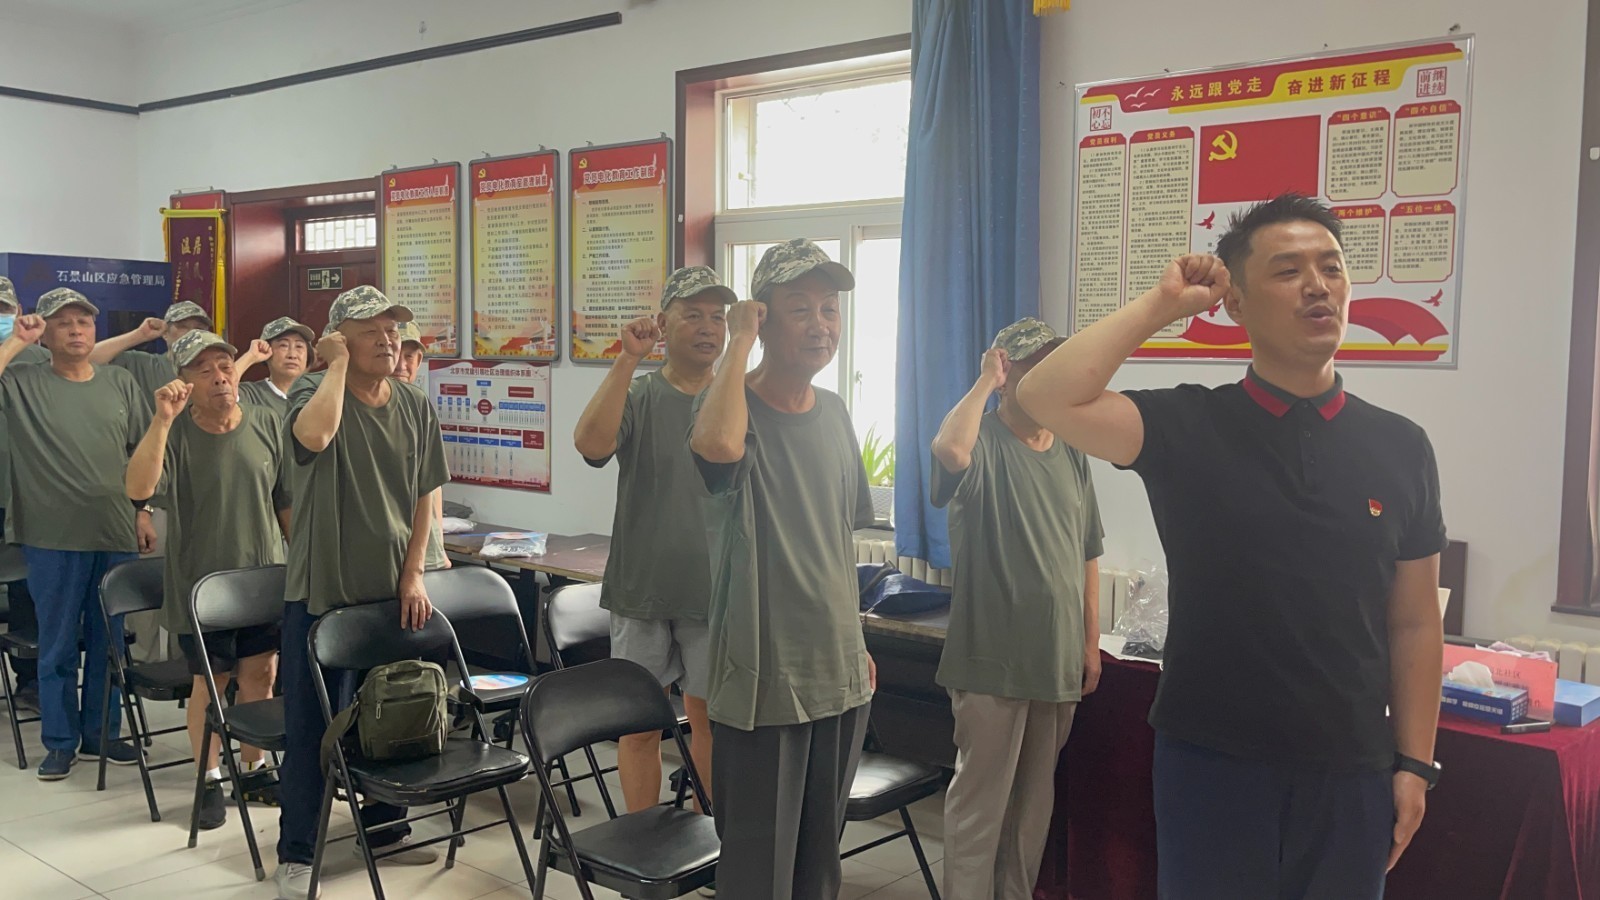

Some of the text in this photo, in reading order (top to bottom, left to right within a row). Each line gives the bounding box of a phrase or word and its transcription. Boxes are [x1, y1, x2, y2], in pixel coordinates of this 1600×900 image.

[1170, 69, 1391, 102] 永远跟党走 奋进新征程
[56, 270, 166, 288] 石景山区应急管理局
